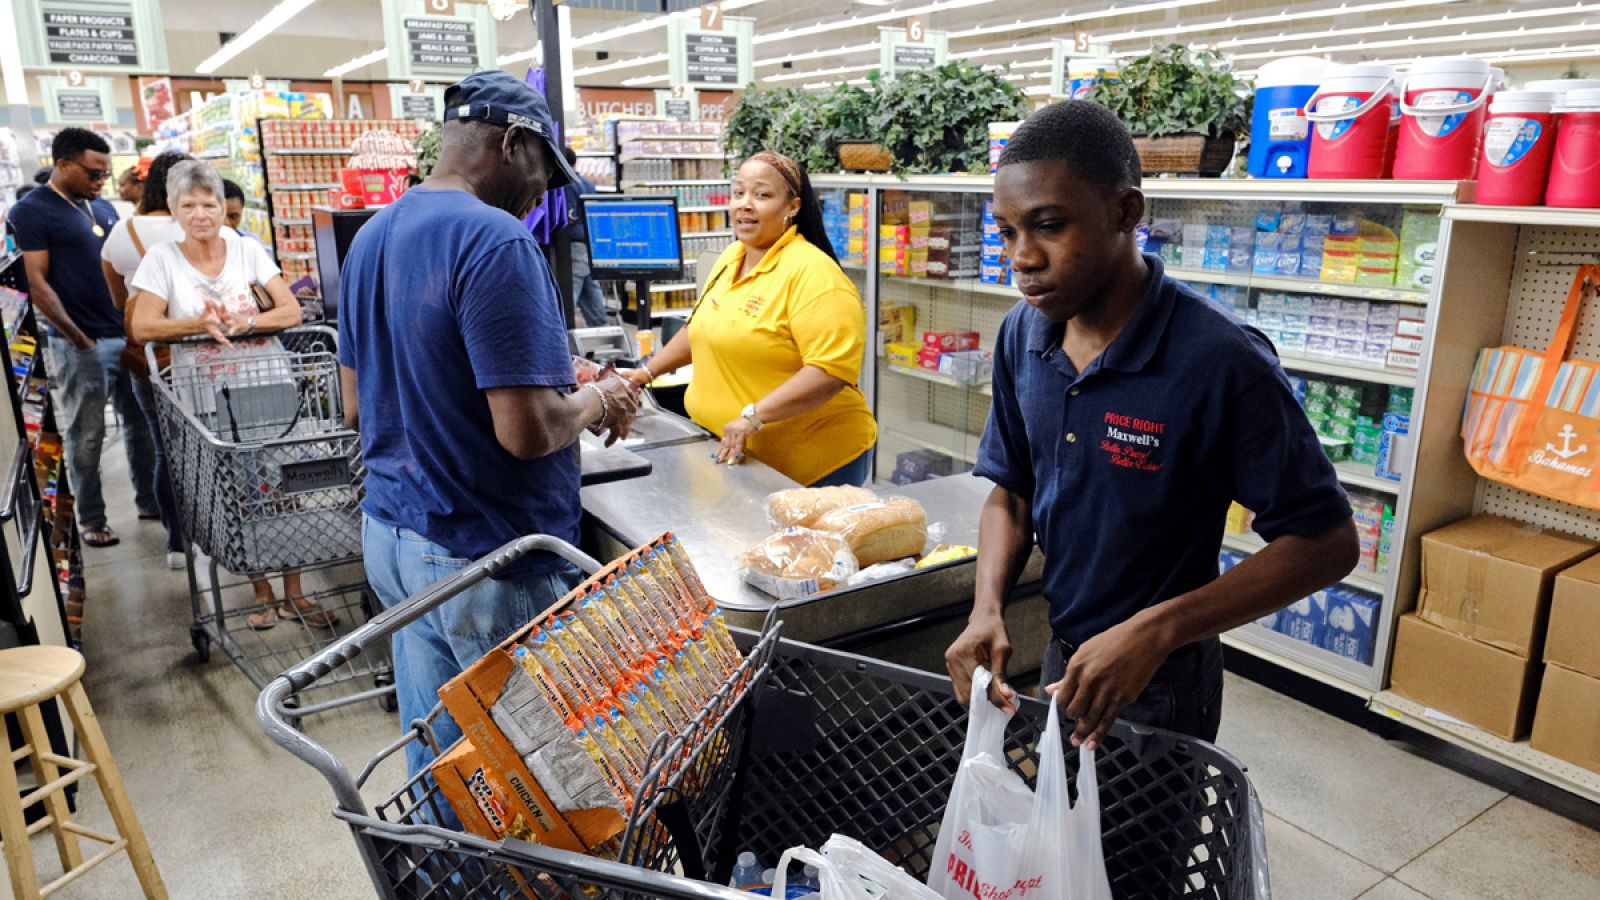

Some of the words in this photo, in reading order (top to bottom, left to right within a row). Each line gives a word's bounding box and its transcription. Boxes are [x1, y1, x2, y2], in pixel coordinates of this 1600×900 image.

[50, 14, 78, 23] PAPER
[80, 15, 125, 26] PRODUCTS
[705, 6, 718, 27] 7
[59, 28, 90, 37] PLATES
[91, 28, 98, 37] &
[100, 29, 123, 39] CUPS
[444, 22, 468, 32] FOODS
[910, 20, 921, 41] 6
[1078, 34, 1088, 50] 5
[68, 54, 120, 64] CHARCOAL
[70, 71, 82, 85] 9
[1104, 412, 1132, 428] PRICE
[1132, 418, 1166, 434] RIGHT
[1106, 426, 1160, 448] Maxwell's
[1528, 449, 1593, 478] Bahamas
[535, 673, 558, 703] Ramen
[555, 701, 569, 717] Top
[510, 776, 543, 819] CHICKEN
